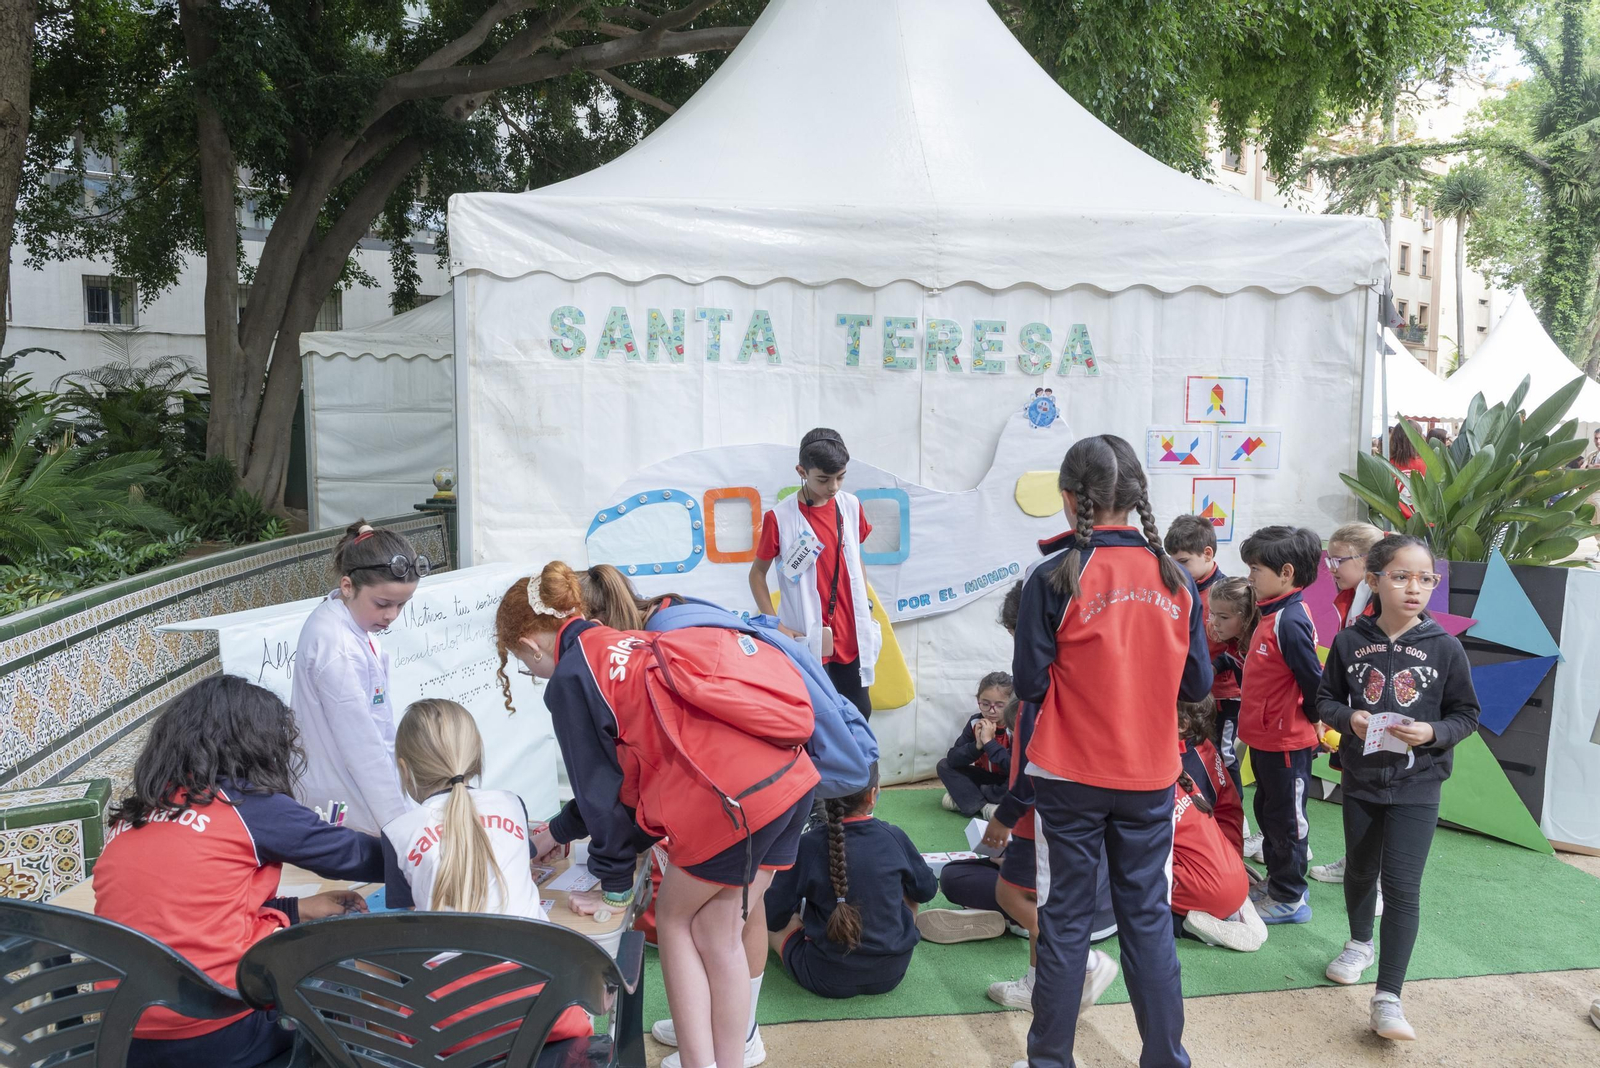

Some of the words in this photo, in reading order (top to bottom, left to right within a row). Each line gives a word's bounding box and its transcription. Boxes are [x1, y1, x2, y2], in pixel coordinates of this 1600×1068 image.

[549, 305, 784, 365] SANTA
[836, 312, 1101, 376] TERESA
[790, 546, 812, 570] BRAILLE
[897, 593, 931, 612] POR
[938, 587, 958, 602] EL
[964, 562, 1020, 594] MUNDO
[1354, 644, 1388, 659] CHANGE
[1393, 644, 1403, 653] IS
[1405, 646, 1428, 662] GOOD
